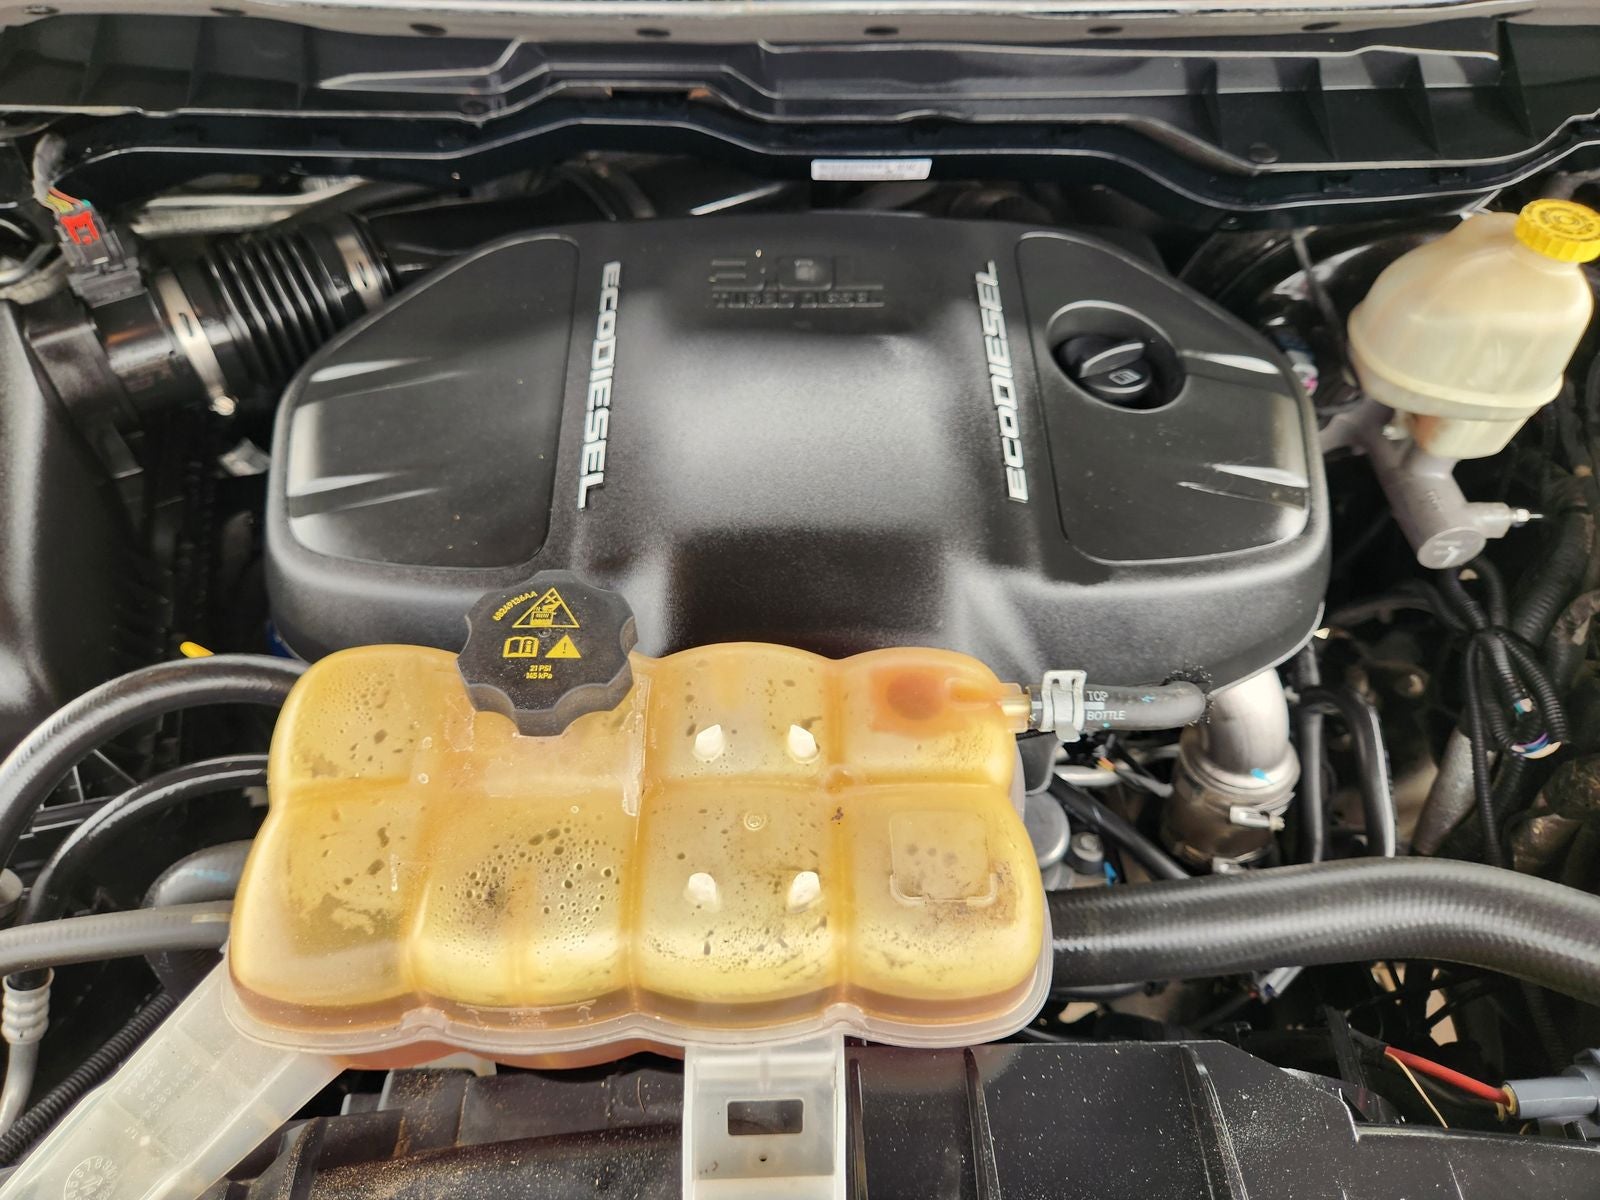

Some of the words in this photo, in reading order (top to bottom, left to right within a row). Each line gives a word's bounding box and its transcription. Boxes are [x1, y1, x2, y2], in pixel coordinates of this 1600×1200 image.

[577, 261, 621, 509] ECODIESEL
[975, 260, 1028, 502] ECODIESEL
[1086, 690, 1109, 702] TOP
[1087, 710, 1127, 720] BOTTLE
